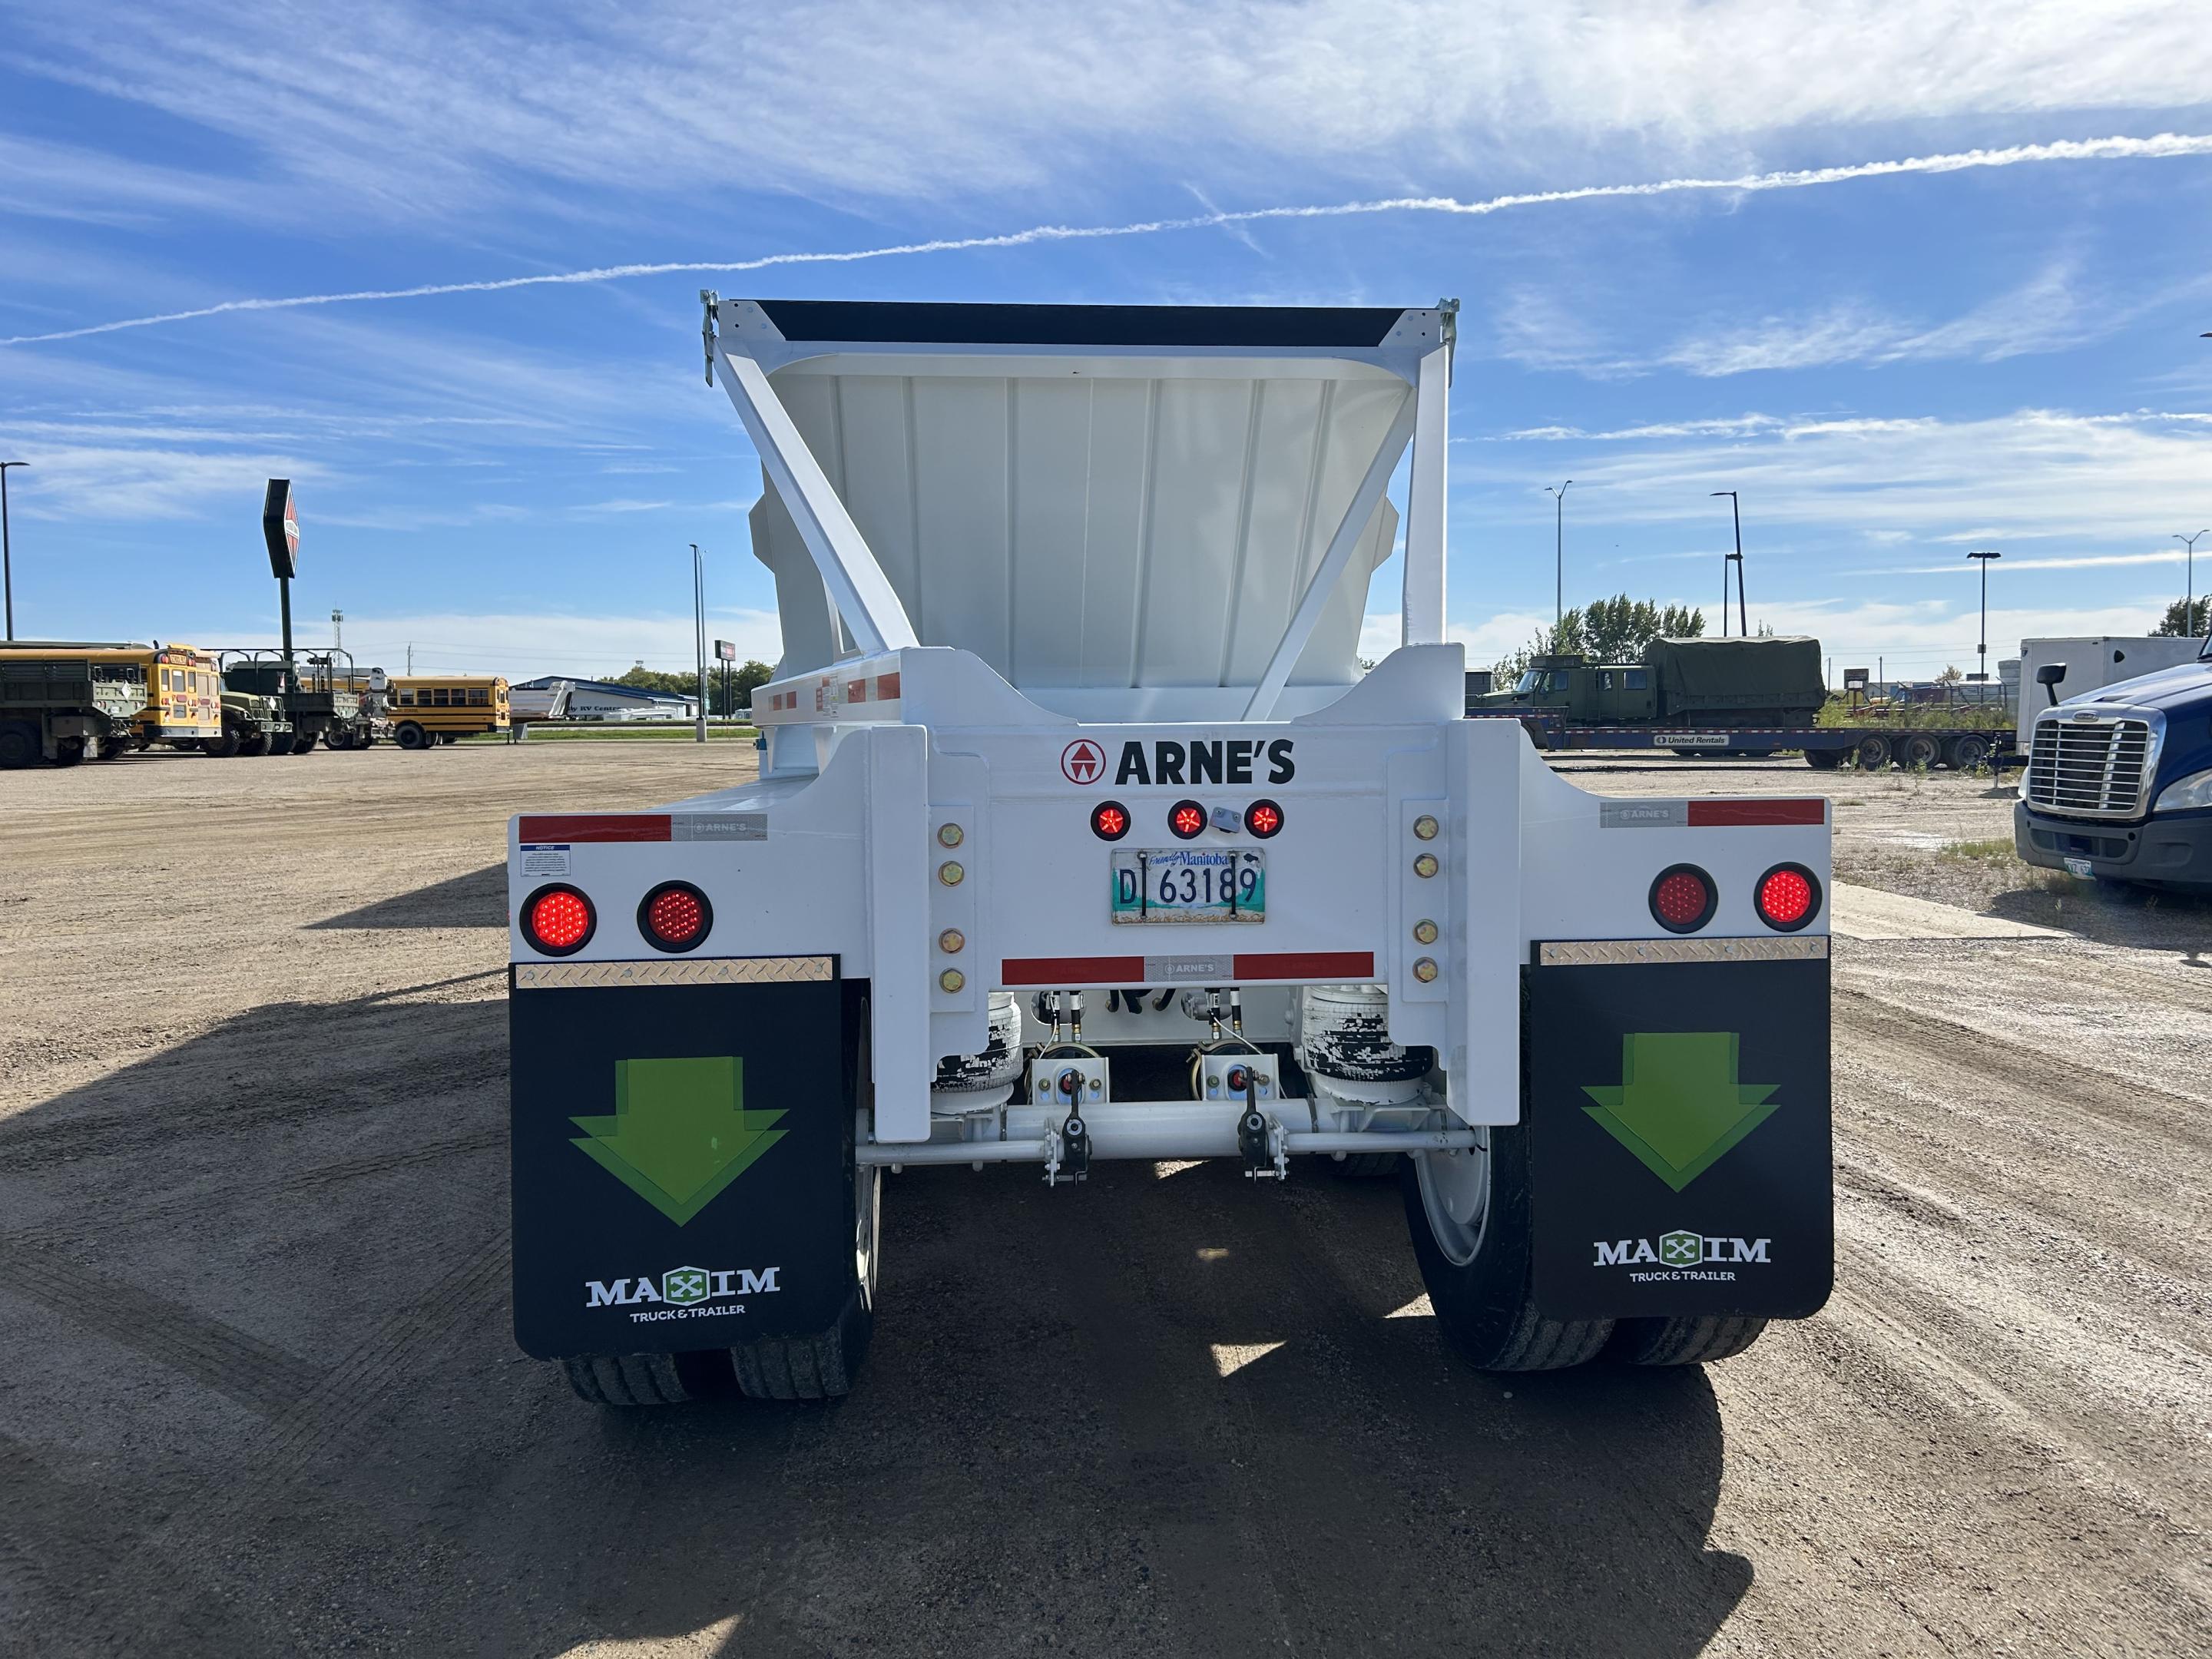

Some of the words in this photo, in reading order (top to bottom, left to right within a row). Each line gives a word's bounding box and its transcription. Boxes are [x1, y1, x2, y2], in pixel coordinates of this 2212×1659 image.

[1114, 739, 1295, 785] ARNE'S
[1631, 810, 1669, 818] ARNE'S
[706, 823, 747, 832] ARNE'S
[1150, 851, 1181, 866] Friendly
[1180, 851, 1229, 866] Manitoba
[1119, 869, 1137, 904] D
[1159, 868, 1257, 903] 63189
[1175, 964, 1214, 972] ARNE'S
[1593, 1230, 1772, 1267] MAXIM
[1629, 1271, 1671, 1283] TRUCK
[1681, 1271, 1737, 1281] TRAILER
[585, 1266, 781, 1307] MAXIM
[629, 1309, 677, 1323] TRUCK
[688, 1304, 747, 1319] TRAILER
